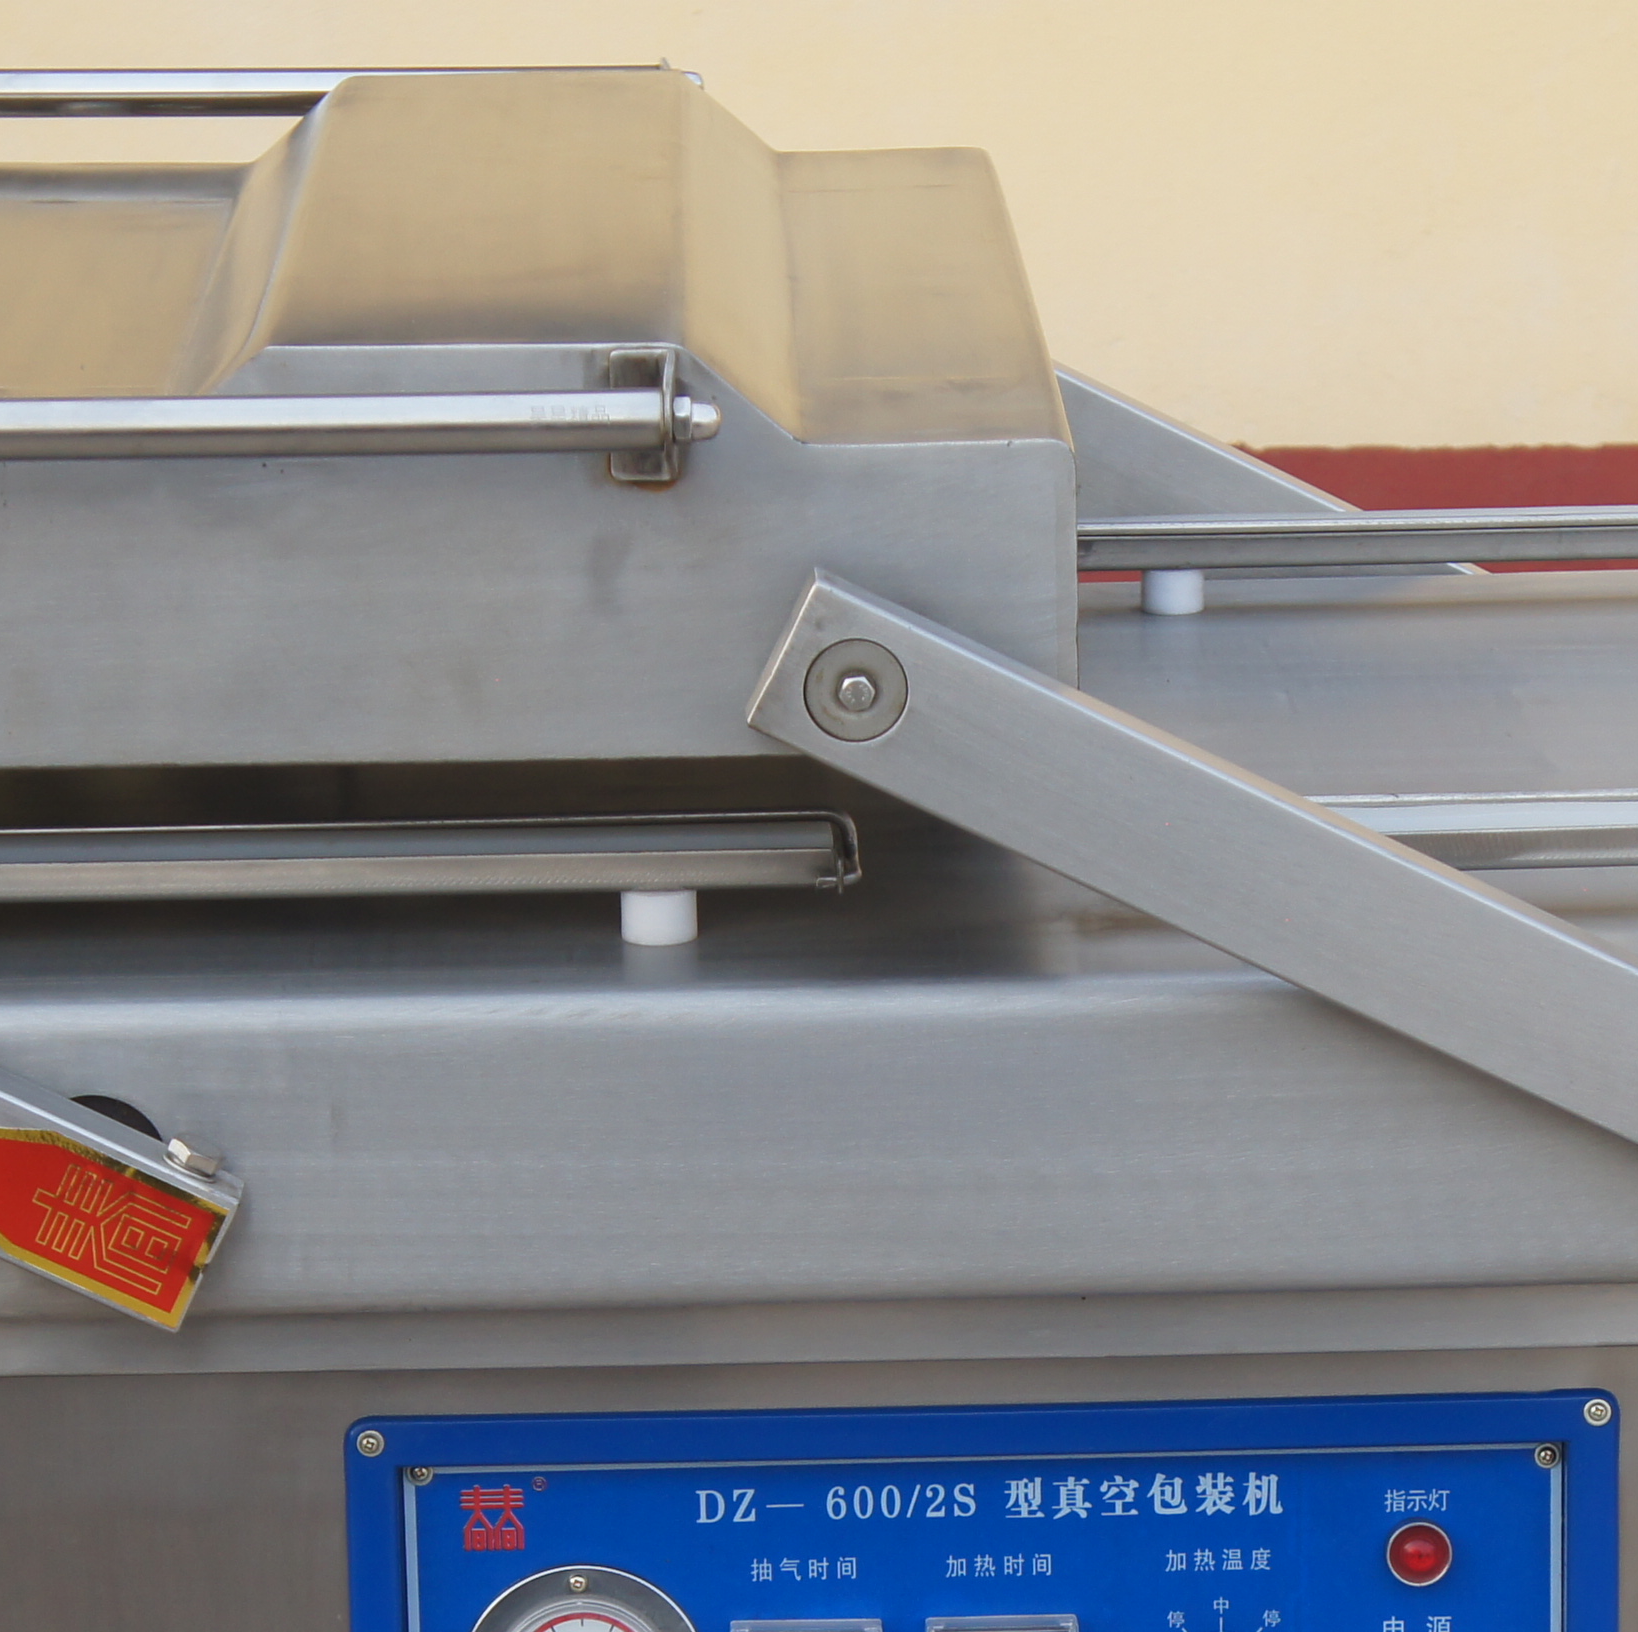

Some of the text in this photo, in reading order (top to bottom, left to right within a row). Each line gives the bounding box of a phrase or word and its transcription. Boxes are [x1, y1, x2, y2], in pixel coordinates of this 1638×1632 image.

[1004, 1471, 1284, 1520] 型真空包装机
[1384, 1488, 1450, 1513] 指示灯
[751, 1557, 857, 1582] 抽气时间
[946, 1553, 1052, 1578] 加热时间
[1165, 1547, 1271, 1572] 加热温度
[1213, 1597, 1229, 1614] 中
[1167, 1611, 1185, 1630] 停
[1263, 1610, 1281, 1627] 停
